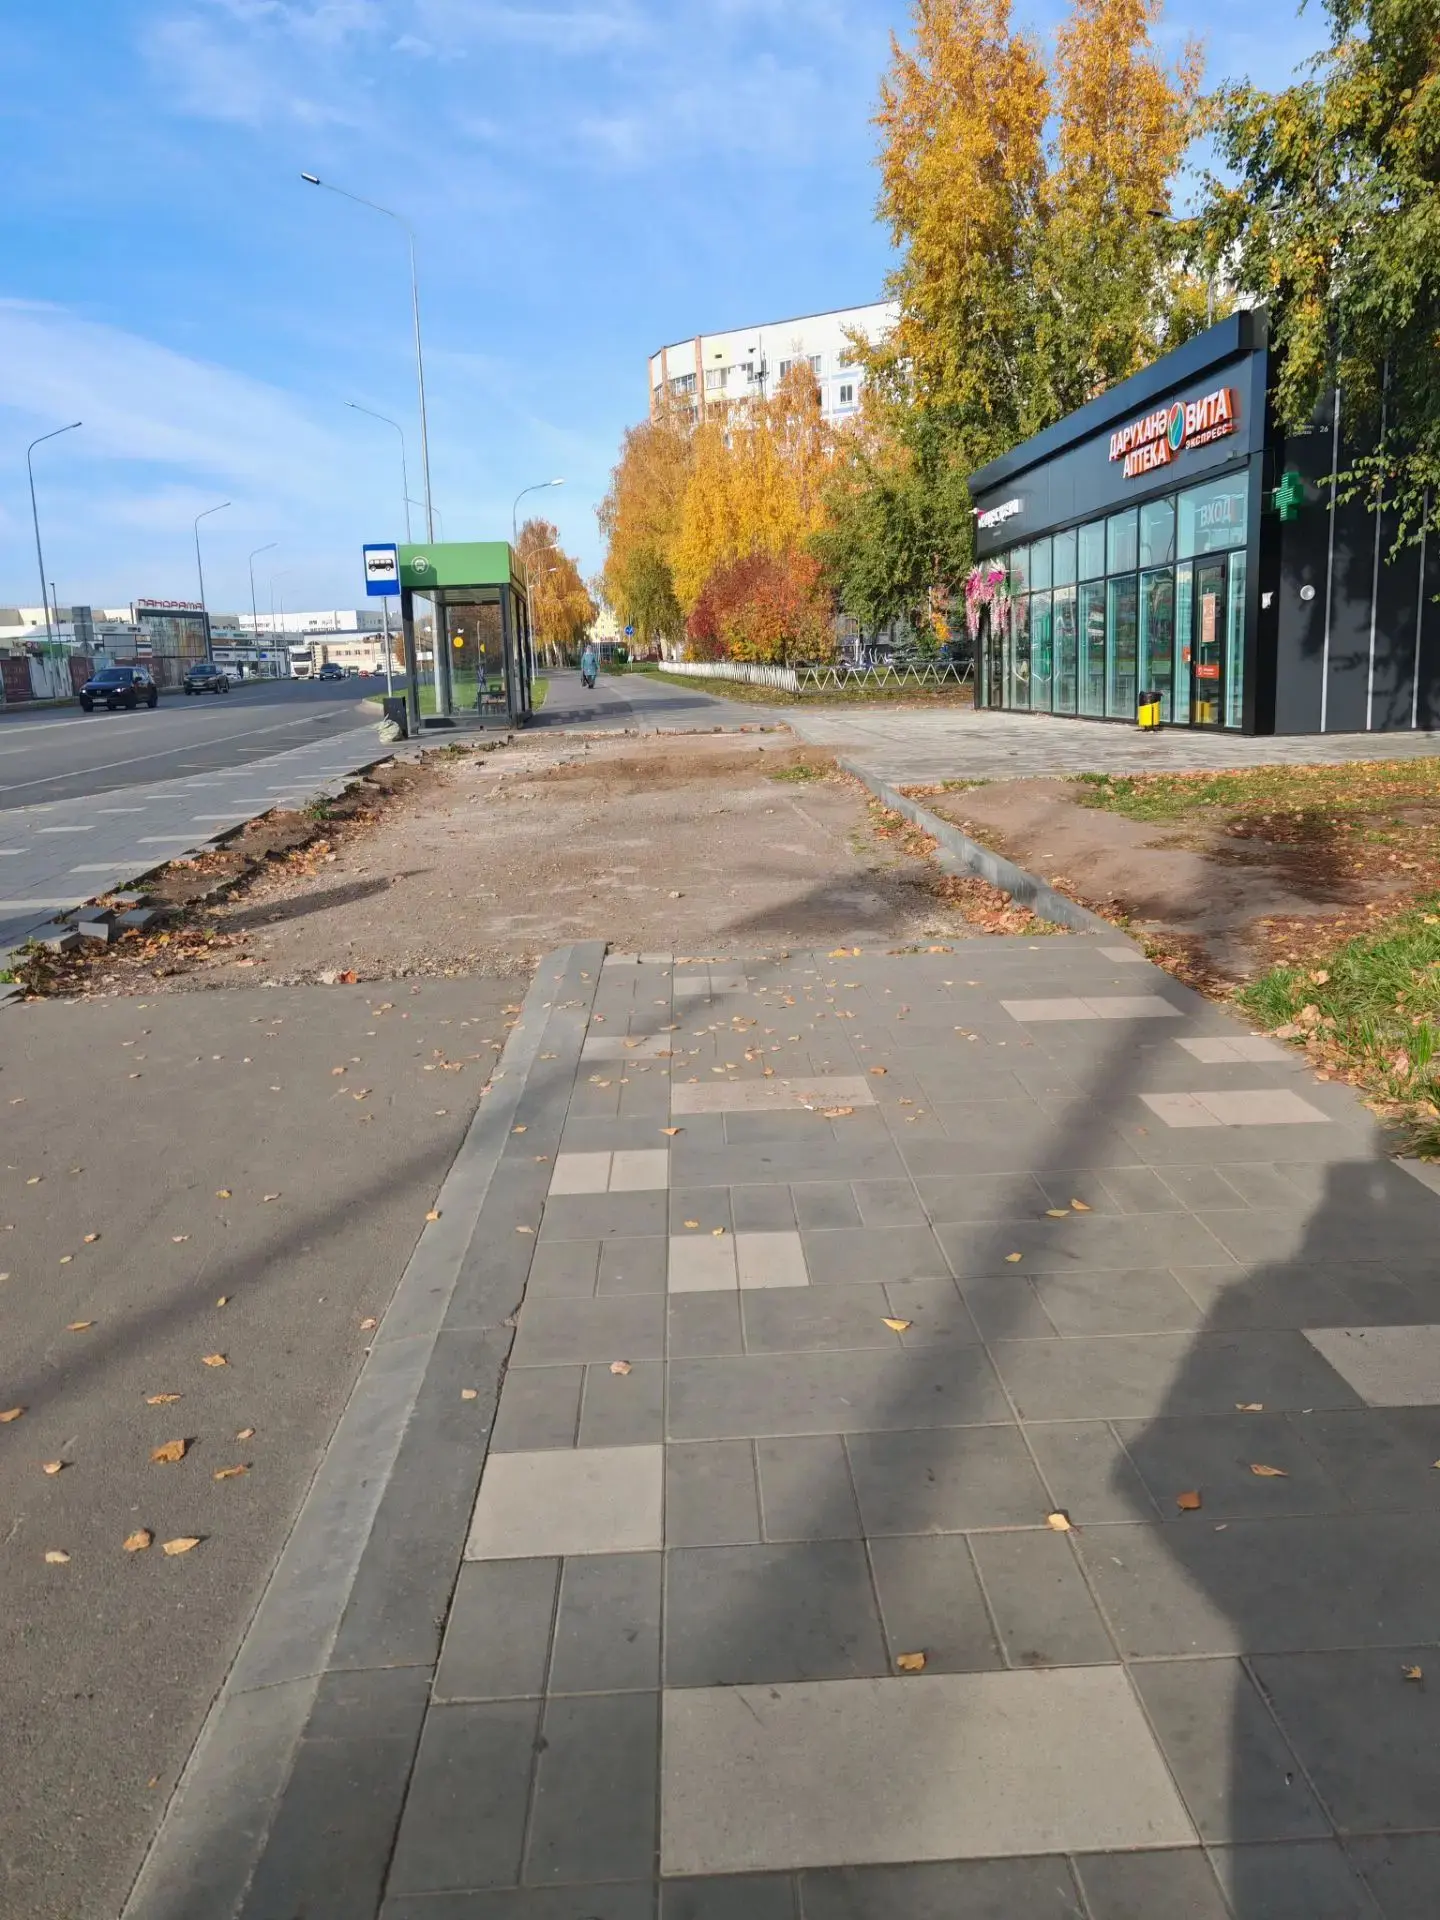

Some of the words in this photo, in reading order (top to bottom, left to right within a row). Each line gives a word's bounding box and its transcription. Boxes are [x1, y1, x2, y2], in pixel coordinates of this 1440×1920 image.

[1186, 389, 1229, 436] ВИТА
[1109, 409, 1167, 461] ДАРУХАНӘ
[1185, 424, 1229, 450] ЭКСПРЕСС
[1123, 438, 1168, 479] АПТЕКА
[1200, 498, 1231, 528] ВХОД
[138, 599, 203, 610] ПАНОРАМА
